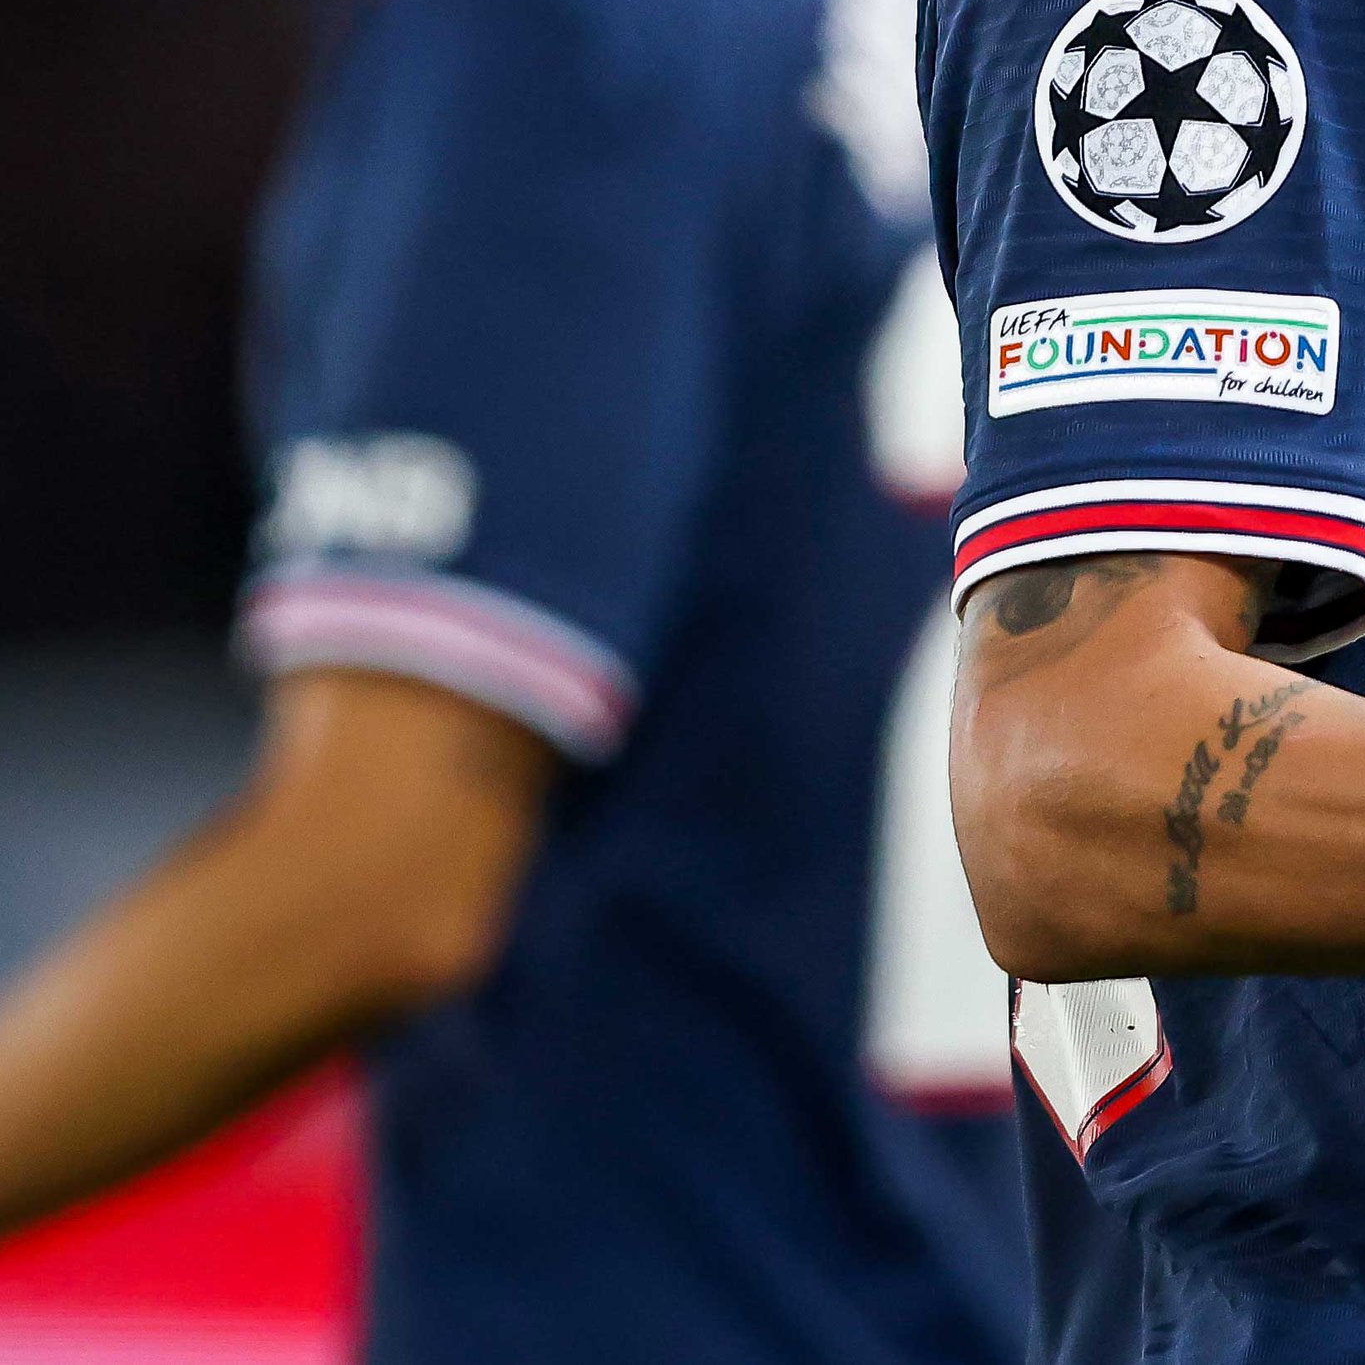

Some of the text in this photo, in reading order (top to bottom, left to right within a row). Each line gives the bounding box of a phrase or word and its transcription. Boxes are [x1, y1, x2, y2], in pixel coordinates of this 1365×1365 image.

[1001, 309, 1069, 337] UEFA
[1219, 372, 1324, 403] for children
